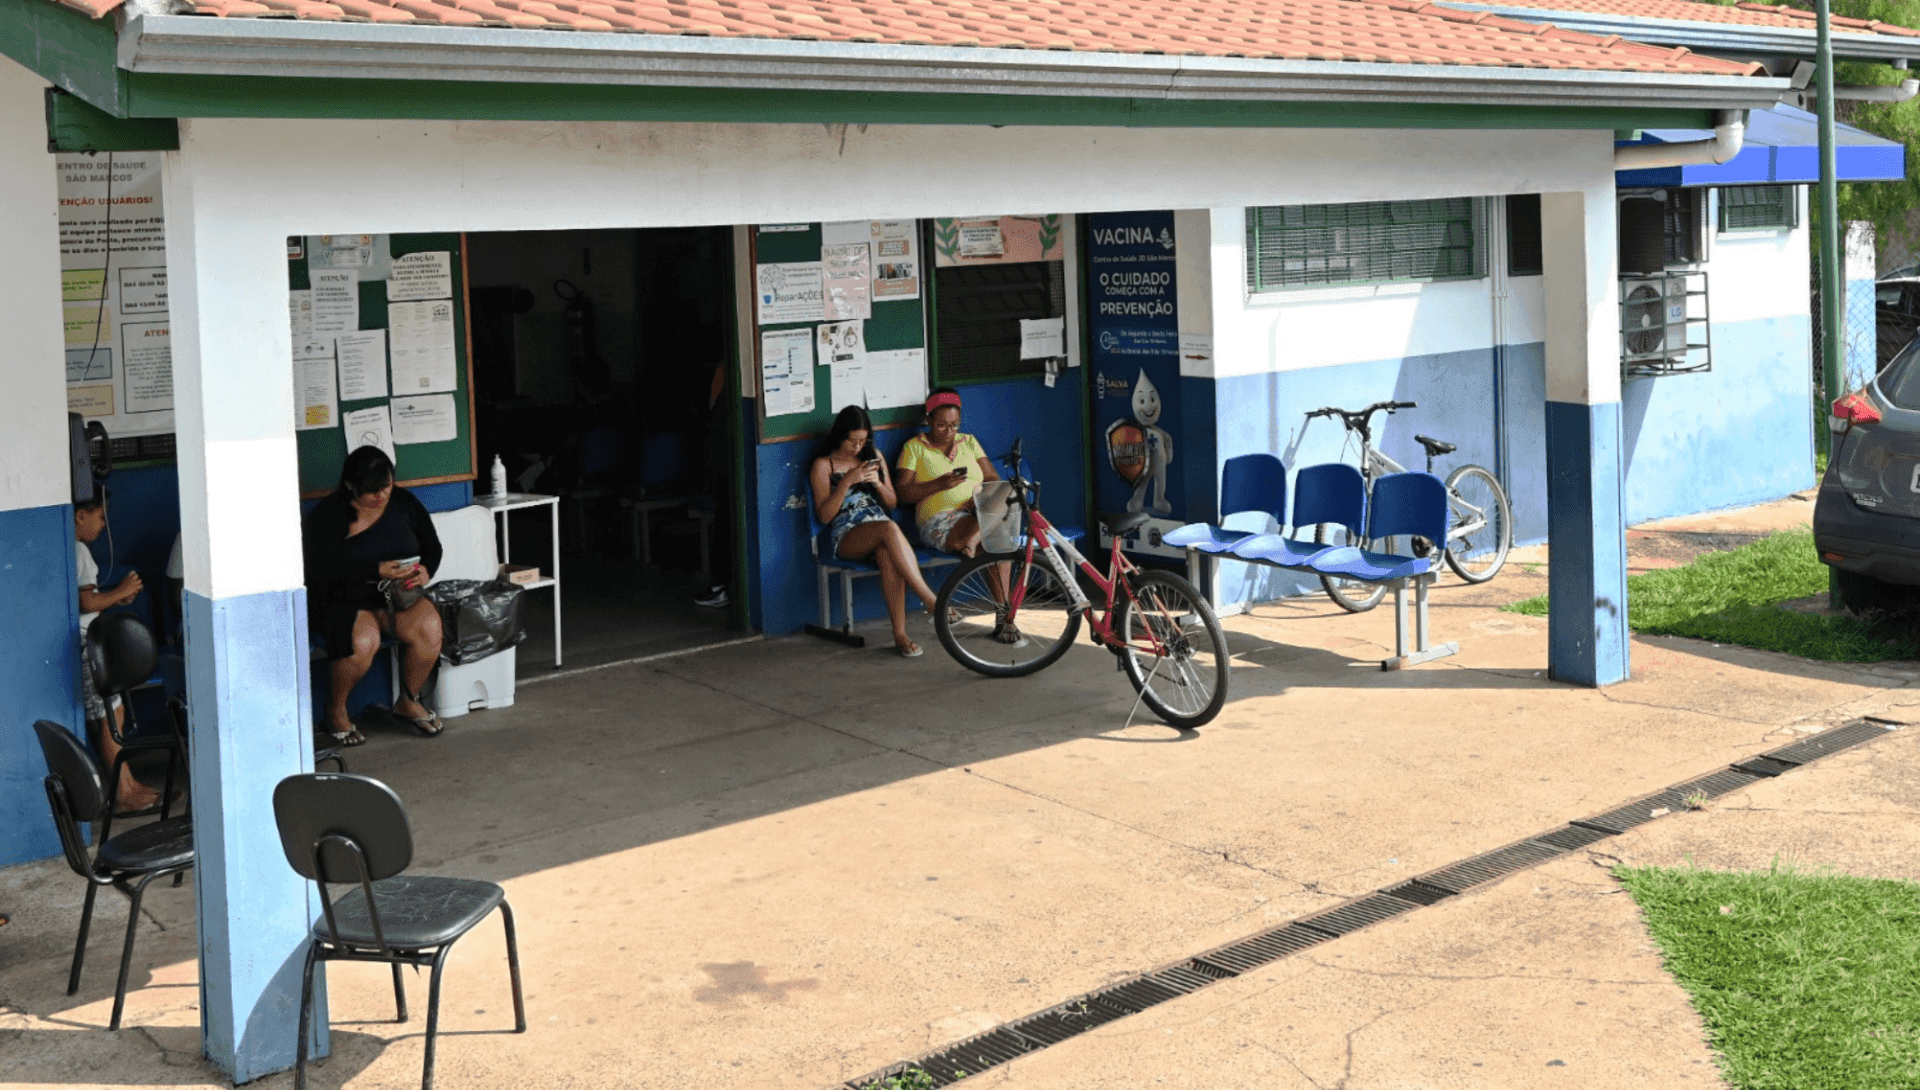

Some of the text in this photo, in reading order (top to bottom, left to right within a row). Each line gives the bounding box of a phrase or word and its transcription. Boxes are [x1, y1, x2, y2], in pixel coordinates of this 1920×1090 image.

[96, 162, 110, 170] DE
[112, 161, 146, 170] SAÚDE
[65, 174, 87, 183] SÃO
[59, 197, 96, 207] ENÇÃO
[97, 228, 132, 236] petence
[1093, 227, 1154, 245] VACINA
[96, 237, 121, 245] Pata,
[401, 253, 435, 263] ATENÇÃO
[1093, 255, 1112, 263] Centro
[1146, 254, 1158, 262] São
[320, 274, 349, 282] ATENÇÃO
[1099, 271, 1171, 287] O CUIDADO
[1105, 286, 1165, 298] COMEÇA COM A
[1100, 299, 1174, 319] PREVENÇÃO
[1670, 306, 1682, 317] LG
[1105, 380, 1129, 389] SALVA
